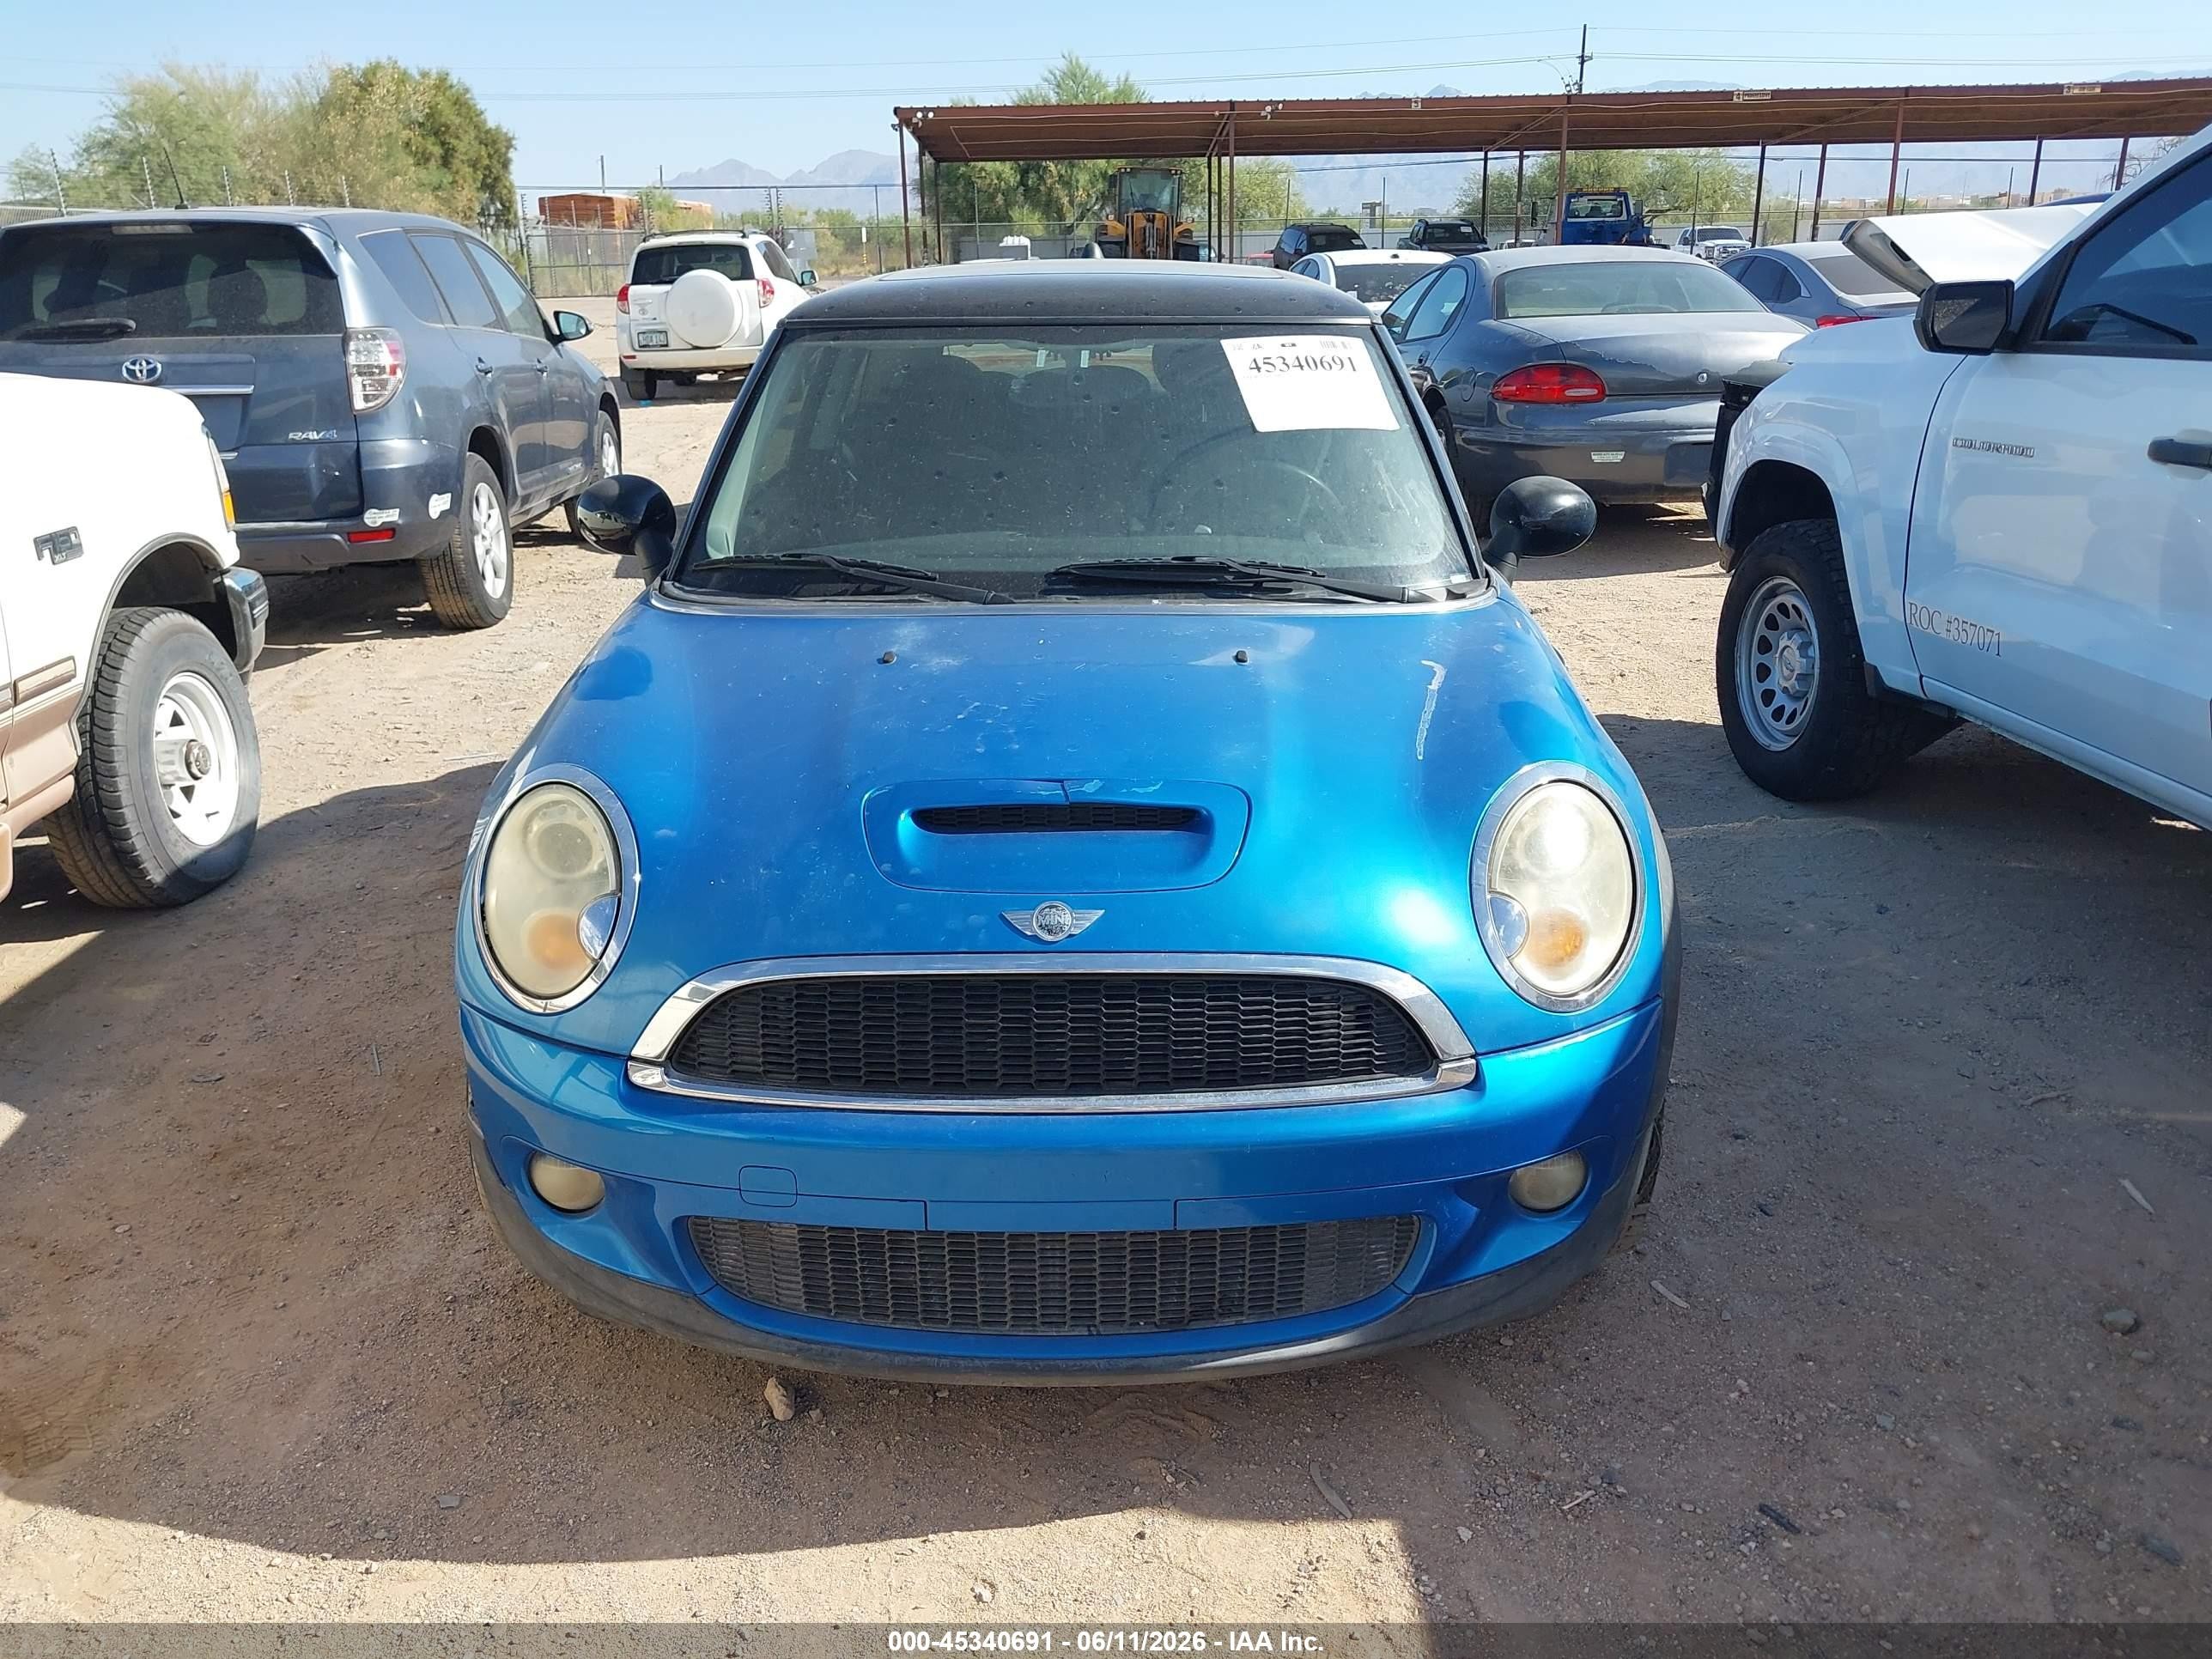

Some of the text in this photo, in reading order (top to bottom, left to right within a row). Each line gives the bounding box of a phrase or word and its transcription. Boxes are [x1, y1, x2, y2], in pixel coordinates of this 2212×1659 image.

[1249, 355, 1357, 373] 45340691
[288, 428, 337, 441] RAV4
[1908, 601, 2002, 658] ROC #357071
